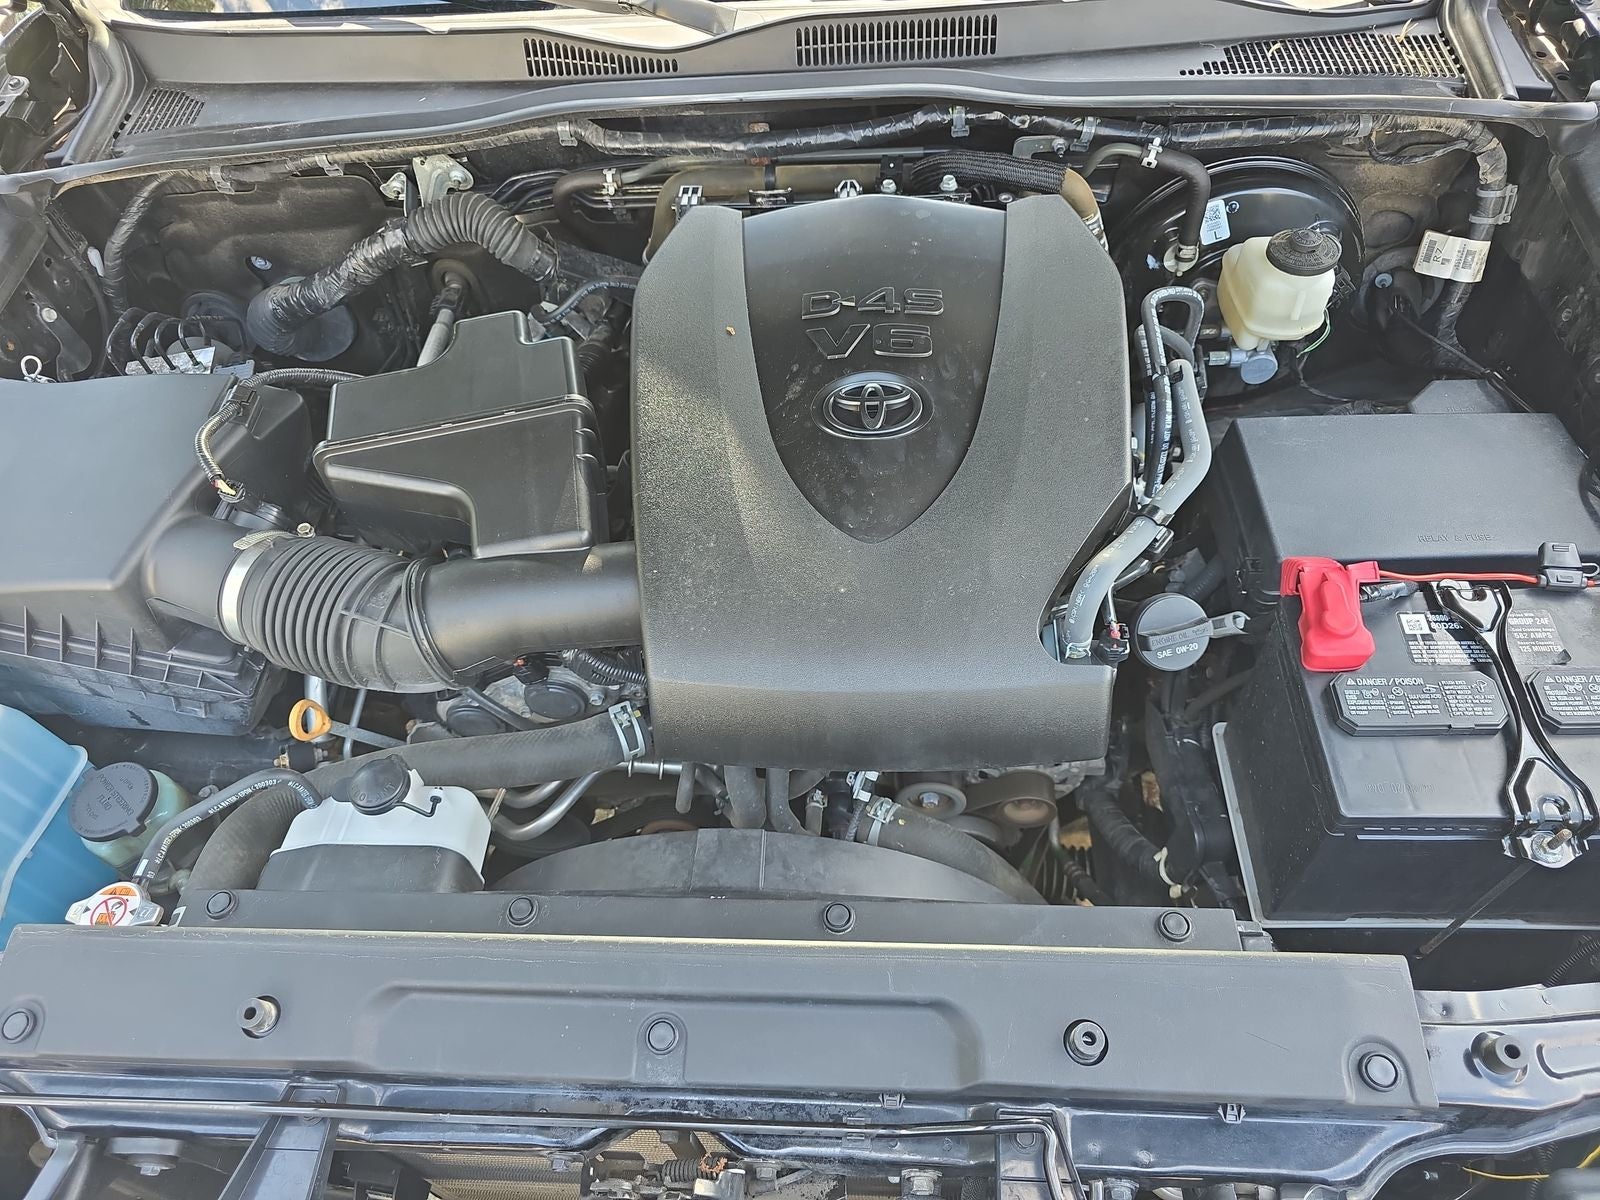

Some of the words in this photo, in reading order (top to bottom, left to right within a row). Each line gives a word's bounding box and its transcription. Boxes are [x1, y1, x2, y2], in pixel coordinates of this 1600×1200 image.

[801, 286, 944, 320] D-4S
[805, 323, 933, 360] V6
[1464, 534, 1491, 542] FUSE
[1508, 617, 1534, 625] GROUP
[1156, 648, 1174, 659] SAE
[1175, 642, 1199, 655] 0W-20
[1356, 677, 1388, 686] DANGER
[1394, 677, 1425, 686] POISON
[1554, 675, 1588, 683] DANGER
